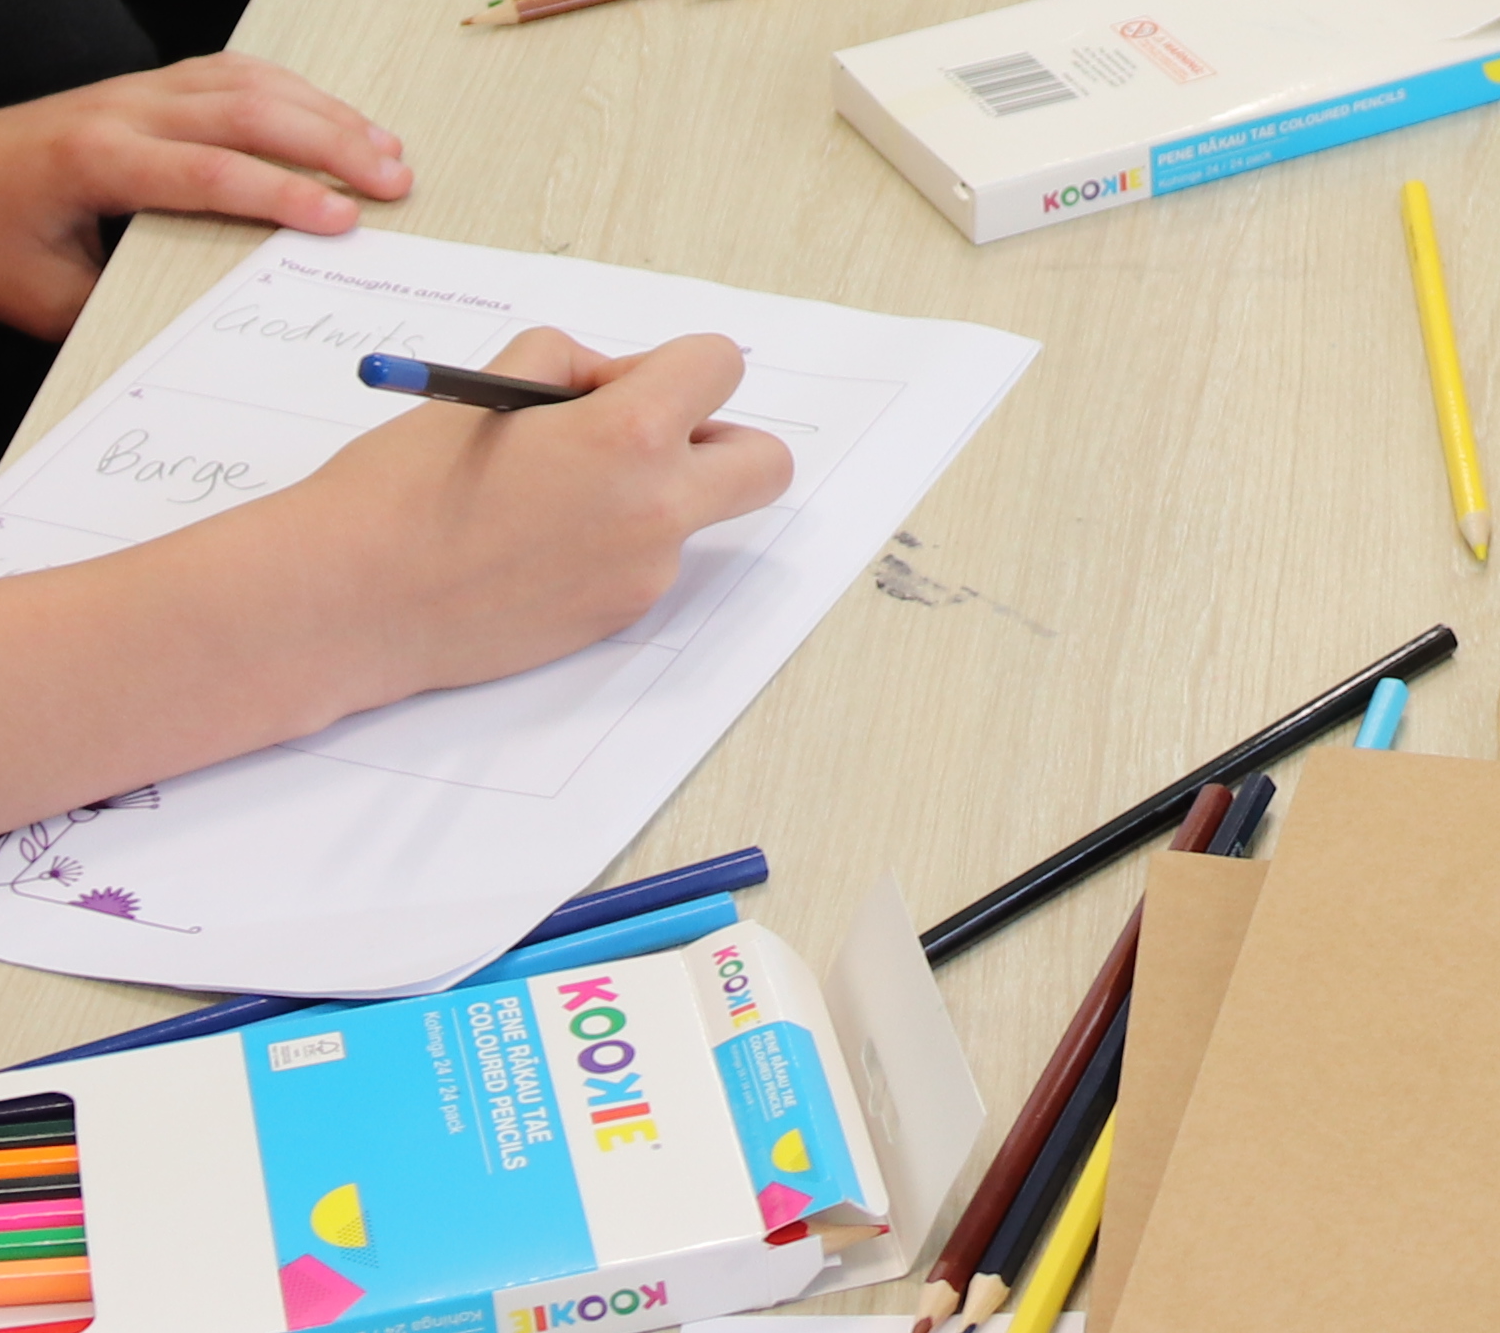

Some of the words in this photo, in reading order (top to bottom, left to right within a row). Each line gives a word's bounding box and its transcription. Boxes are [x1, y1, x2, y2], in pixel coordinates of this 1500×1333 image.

[1156, 141, 1198, 169] PENE
[1278, 100, 1352, 138] COLOURED
[1041, 164, 1145, 215] KOOKIE
[278, 255, 322, 279] Your
[323, 269, 411, 296] thoughts
[413, 286, 455, 304] and
[455, 291, 514, 313] ideas
[96, 428, 269, 504] Barge
[712, 944, 760, 1028] KOOKIE
[421, 1010, 449, 1059] Kohinga
[493, 995, 526, 1042] PENE
[432, 1058, 453, 1077] 24
[465, 1000, 510, 1094] COLOURED
[508, 1043, 545, 1105] RĀKAU
[557, 976, 659, 1153] KOOKIE
[438, 1085, 460, 1103] 24
[438, 1103, 466, 1136] pack
[487, 1095, 528, 1171] PENCILS
[521, 1108, 553, 1145] TAE
[508, 1280, 669, 1333] KOOKIE
